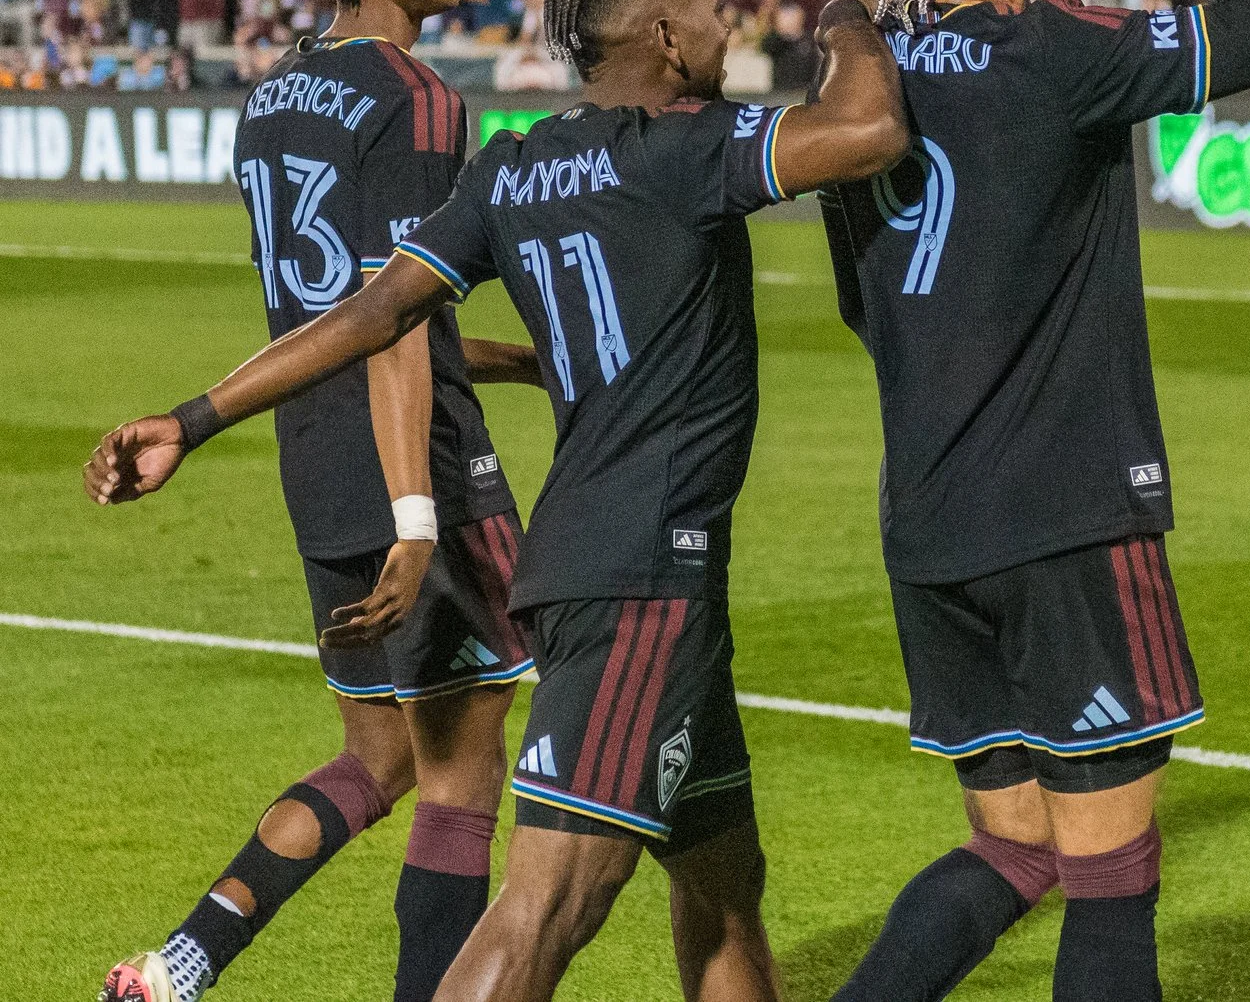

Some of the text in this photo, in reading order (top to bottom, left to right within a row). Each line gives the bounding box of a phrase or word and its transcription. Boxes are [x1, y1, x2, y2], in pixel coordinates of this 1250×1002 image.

[80, 106, 127, 182] A
[871, 136, 956, 295] 9
[241, 153, 352, 311] 13
[518, 231, 631, 402] 11
